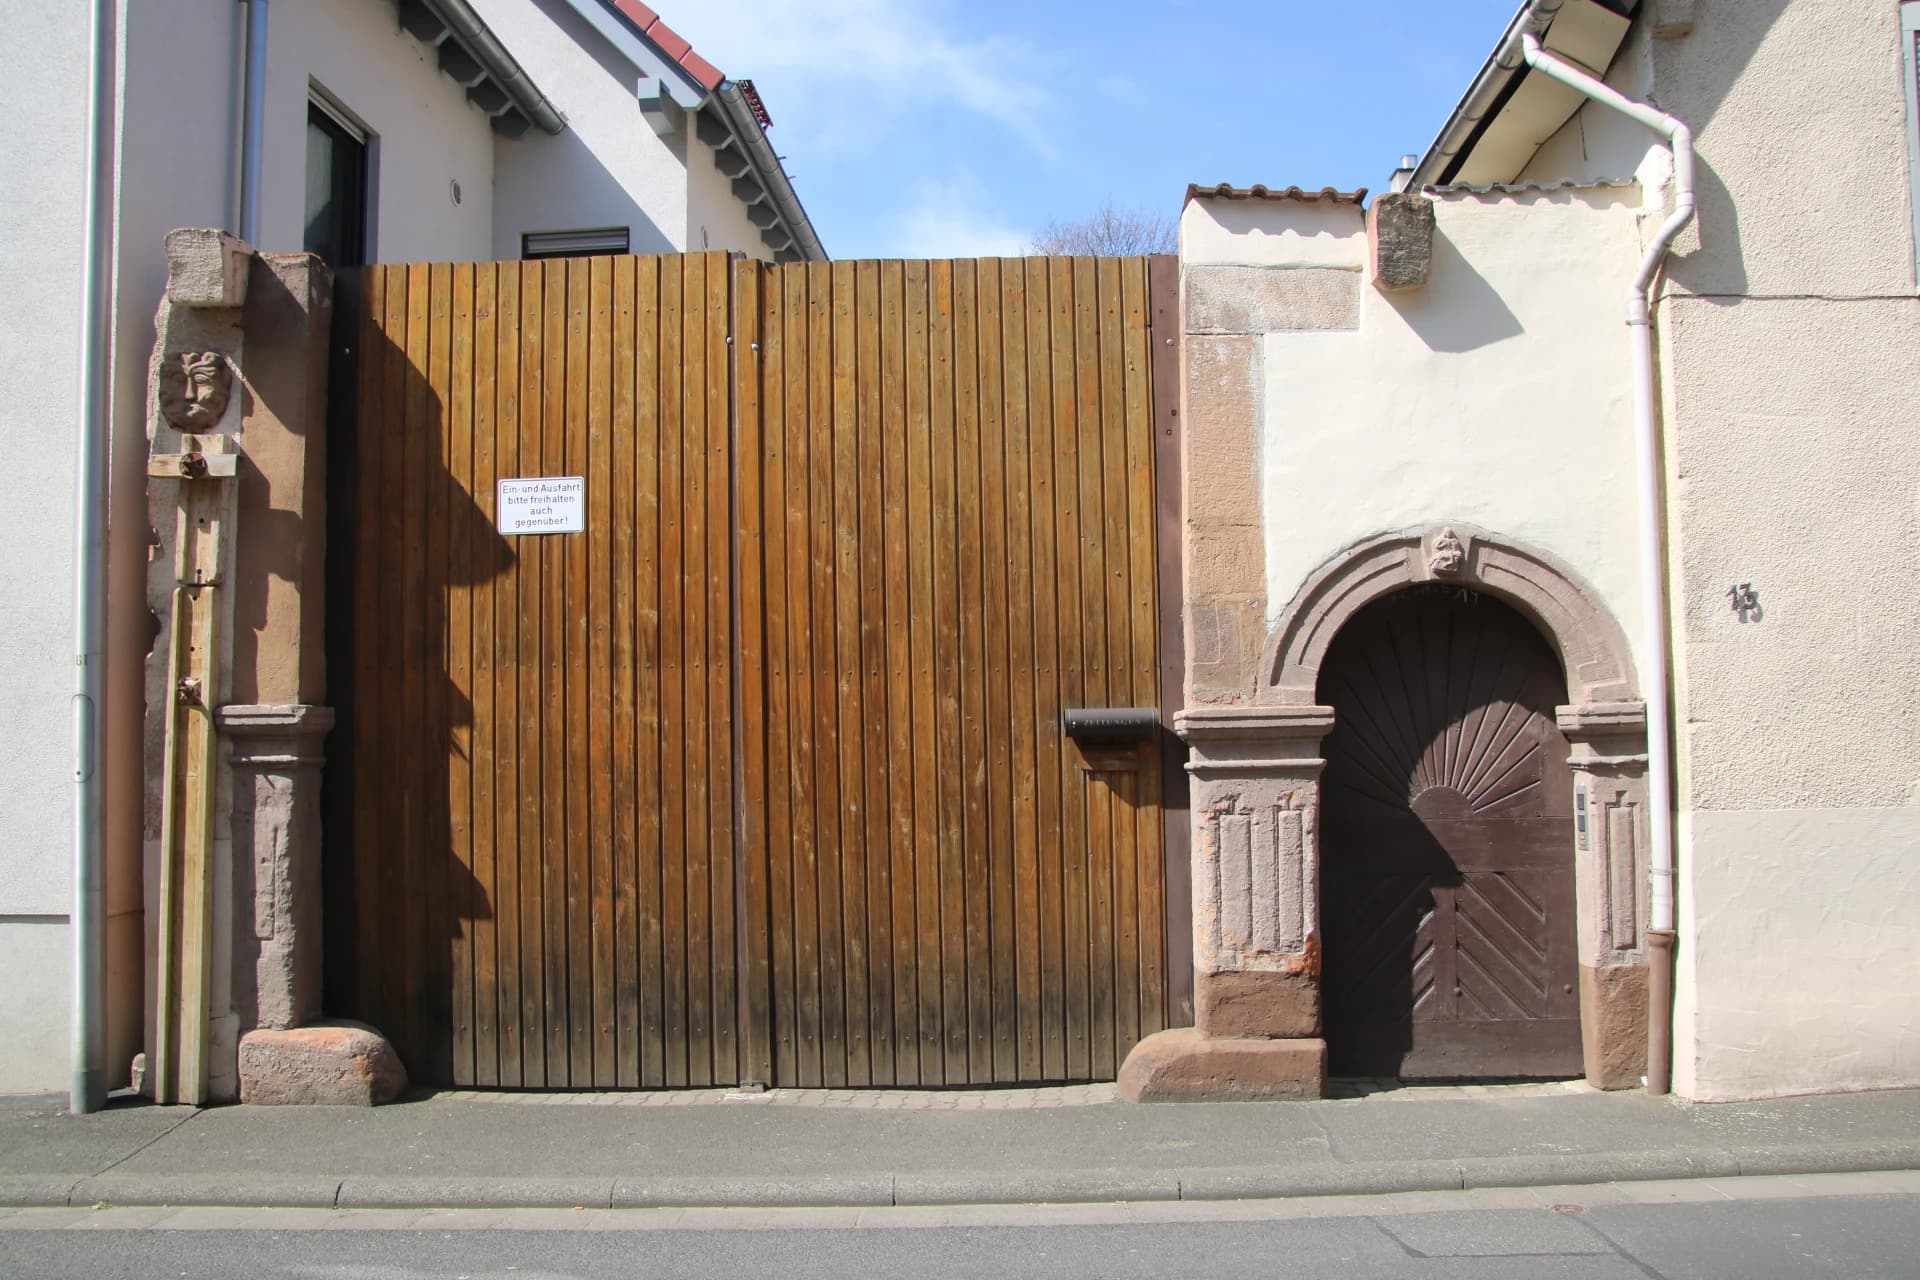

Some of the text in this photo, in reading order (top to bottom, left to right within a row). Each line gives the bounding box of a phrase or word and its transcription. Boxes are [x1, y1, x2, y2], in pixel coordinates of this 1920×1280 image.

[503, 483, 580, 494] Ein- und Ausfahrt
[508, 495, 575, 505] bitte freihalten
[530, 506, 553, 515] auch
[514, 517, 568, 528] gegenüber!
[1725, 582, 1757, 610] 13
